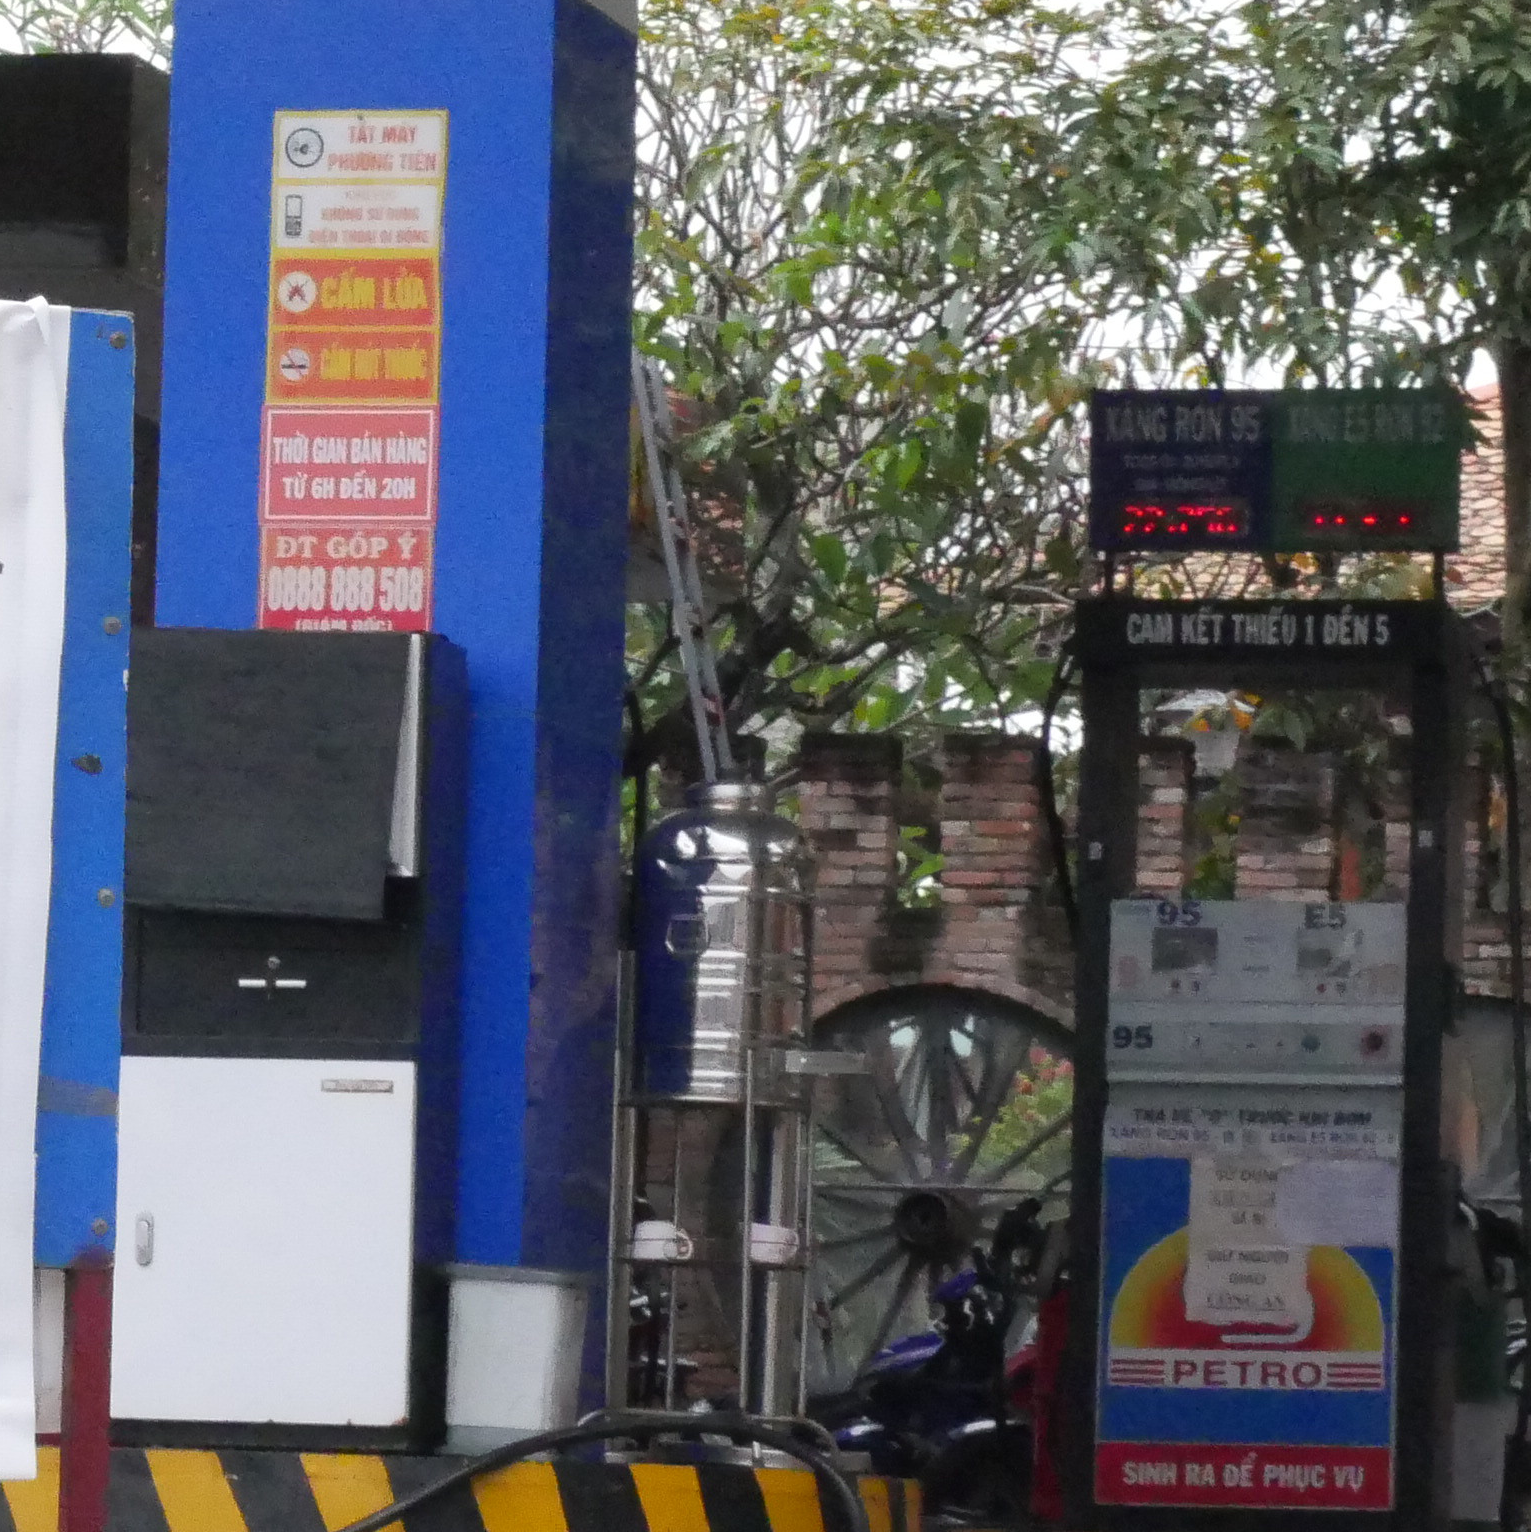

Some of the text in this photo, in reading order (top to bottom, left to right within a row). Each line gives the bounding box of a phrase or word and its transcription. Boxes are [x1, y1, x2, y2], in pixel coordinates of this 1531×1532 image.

[312, 437, 347, 464] GIAN
[381, 477, 416, 499] 20H
[276, 536, 319, 559] ĐT
[1126, 614, 1173, 645] CAM
[1305, 615, 1314, 645] 1
[1374, 615, 1390, 645] 5
[1156, 900, 1203, 927] 95
[1305, 903, 1347, 929] E5
[1112, 1025, 1154, 1049] 95
[1173, 1360, 1323, 1389] PETRO
[1123, 1461, 1177, 1486] SINH
[1185, 1463, 1215, 1486] RA
[1263, 1464, 1326, 1492] PHỤC
[1333, 1465, 1365, 1493] VỤ
